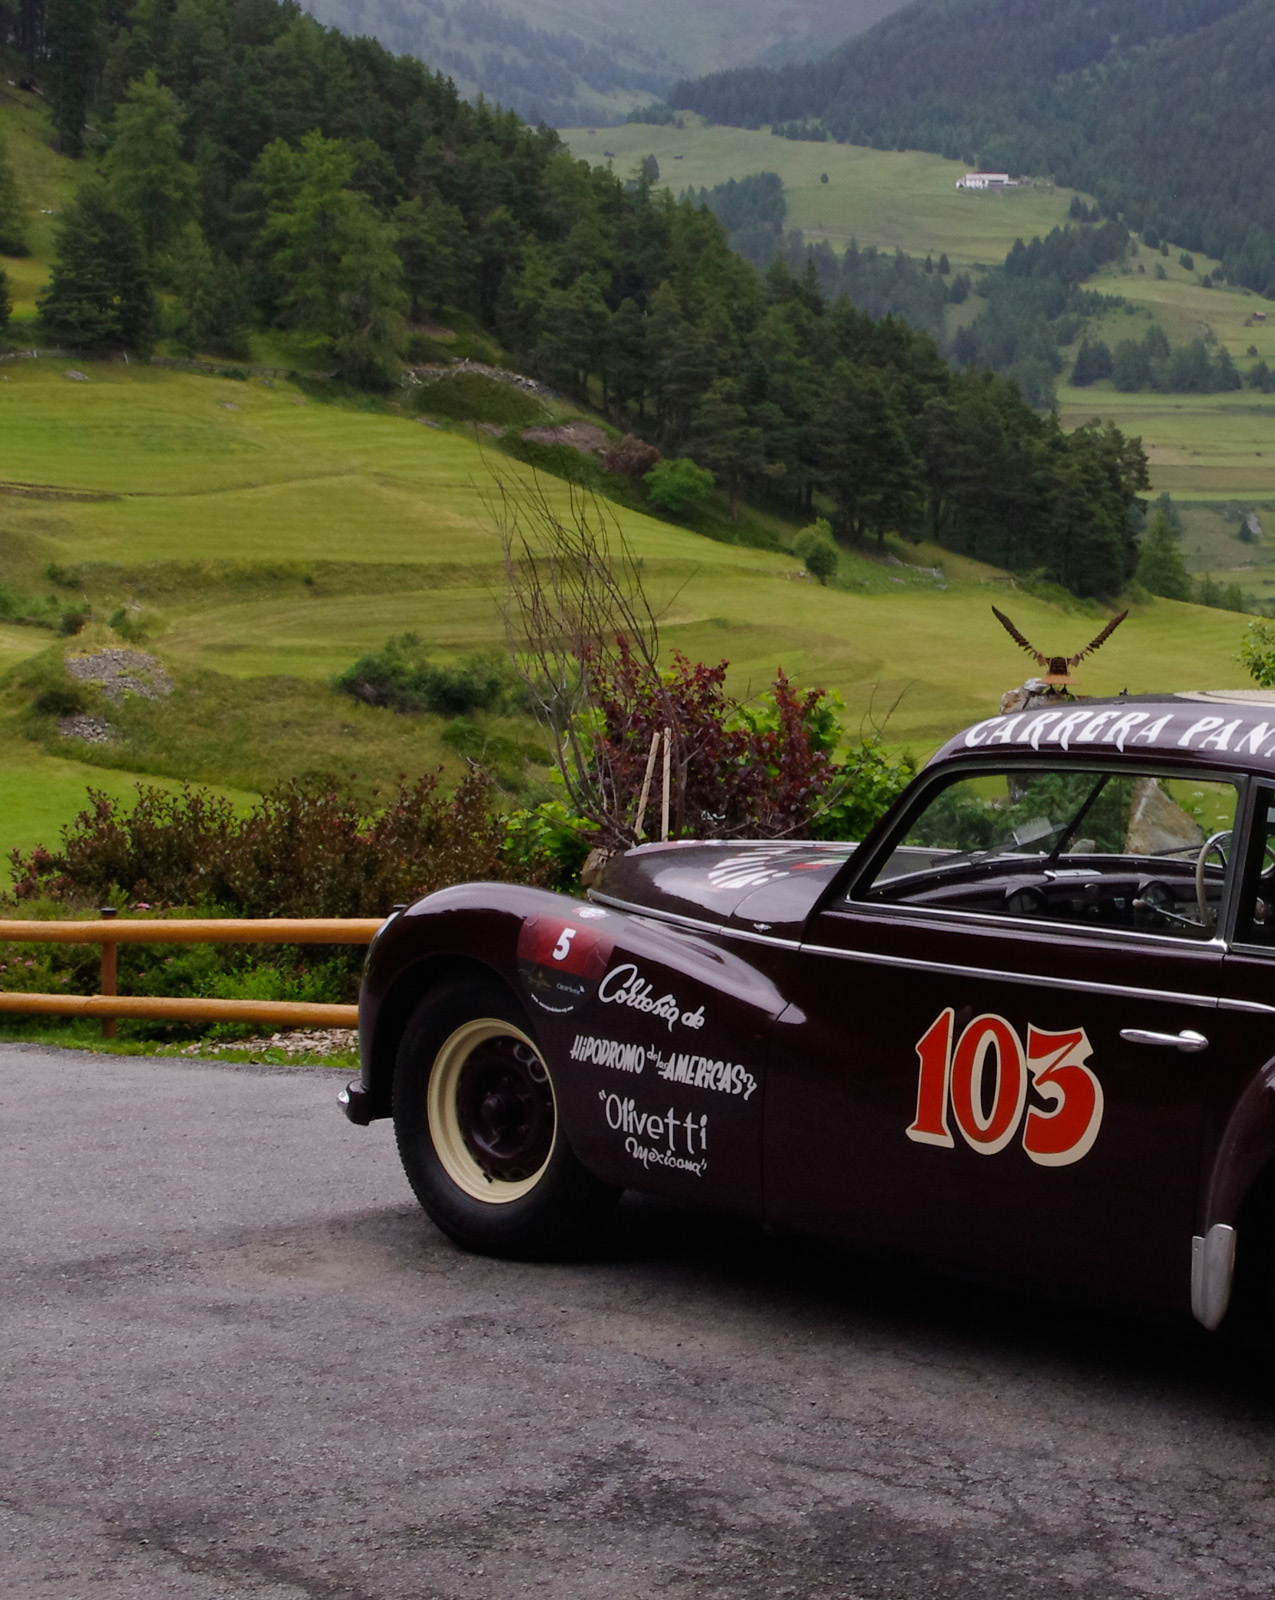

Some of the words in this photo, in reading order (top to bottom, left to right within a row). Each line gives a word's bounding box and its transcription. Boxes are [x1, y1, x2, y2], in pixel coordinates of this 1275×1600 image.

[964, 711, 1175, 752] CARRERA
[552, 927, 577, 961] 5
[681, 1005, 706, 1030] de
[905, 1006, 1104, 1167] 103
